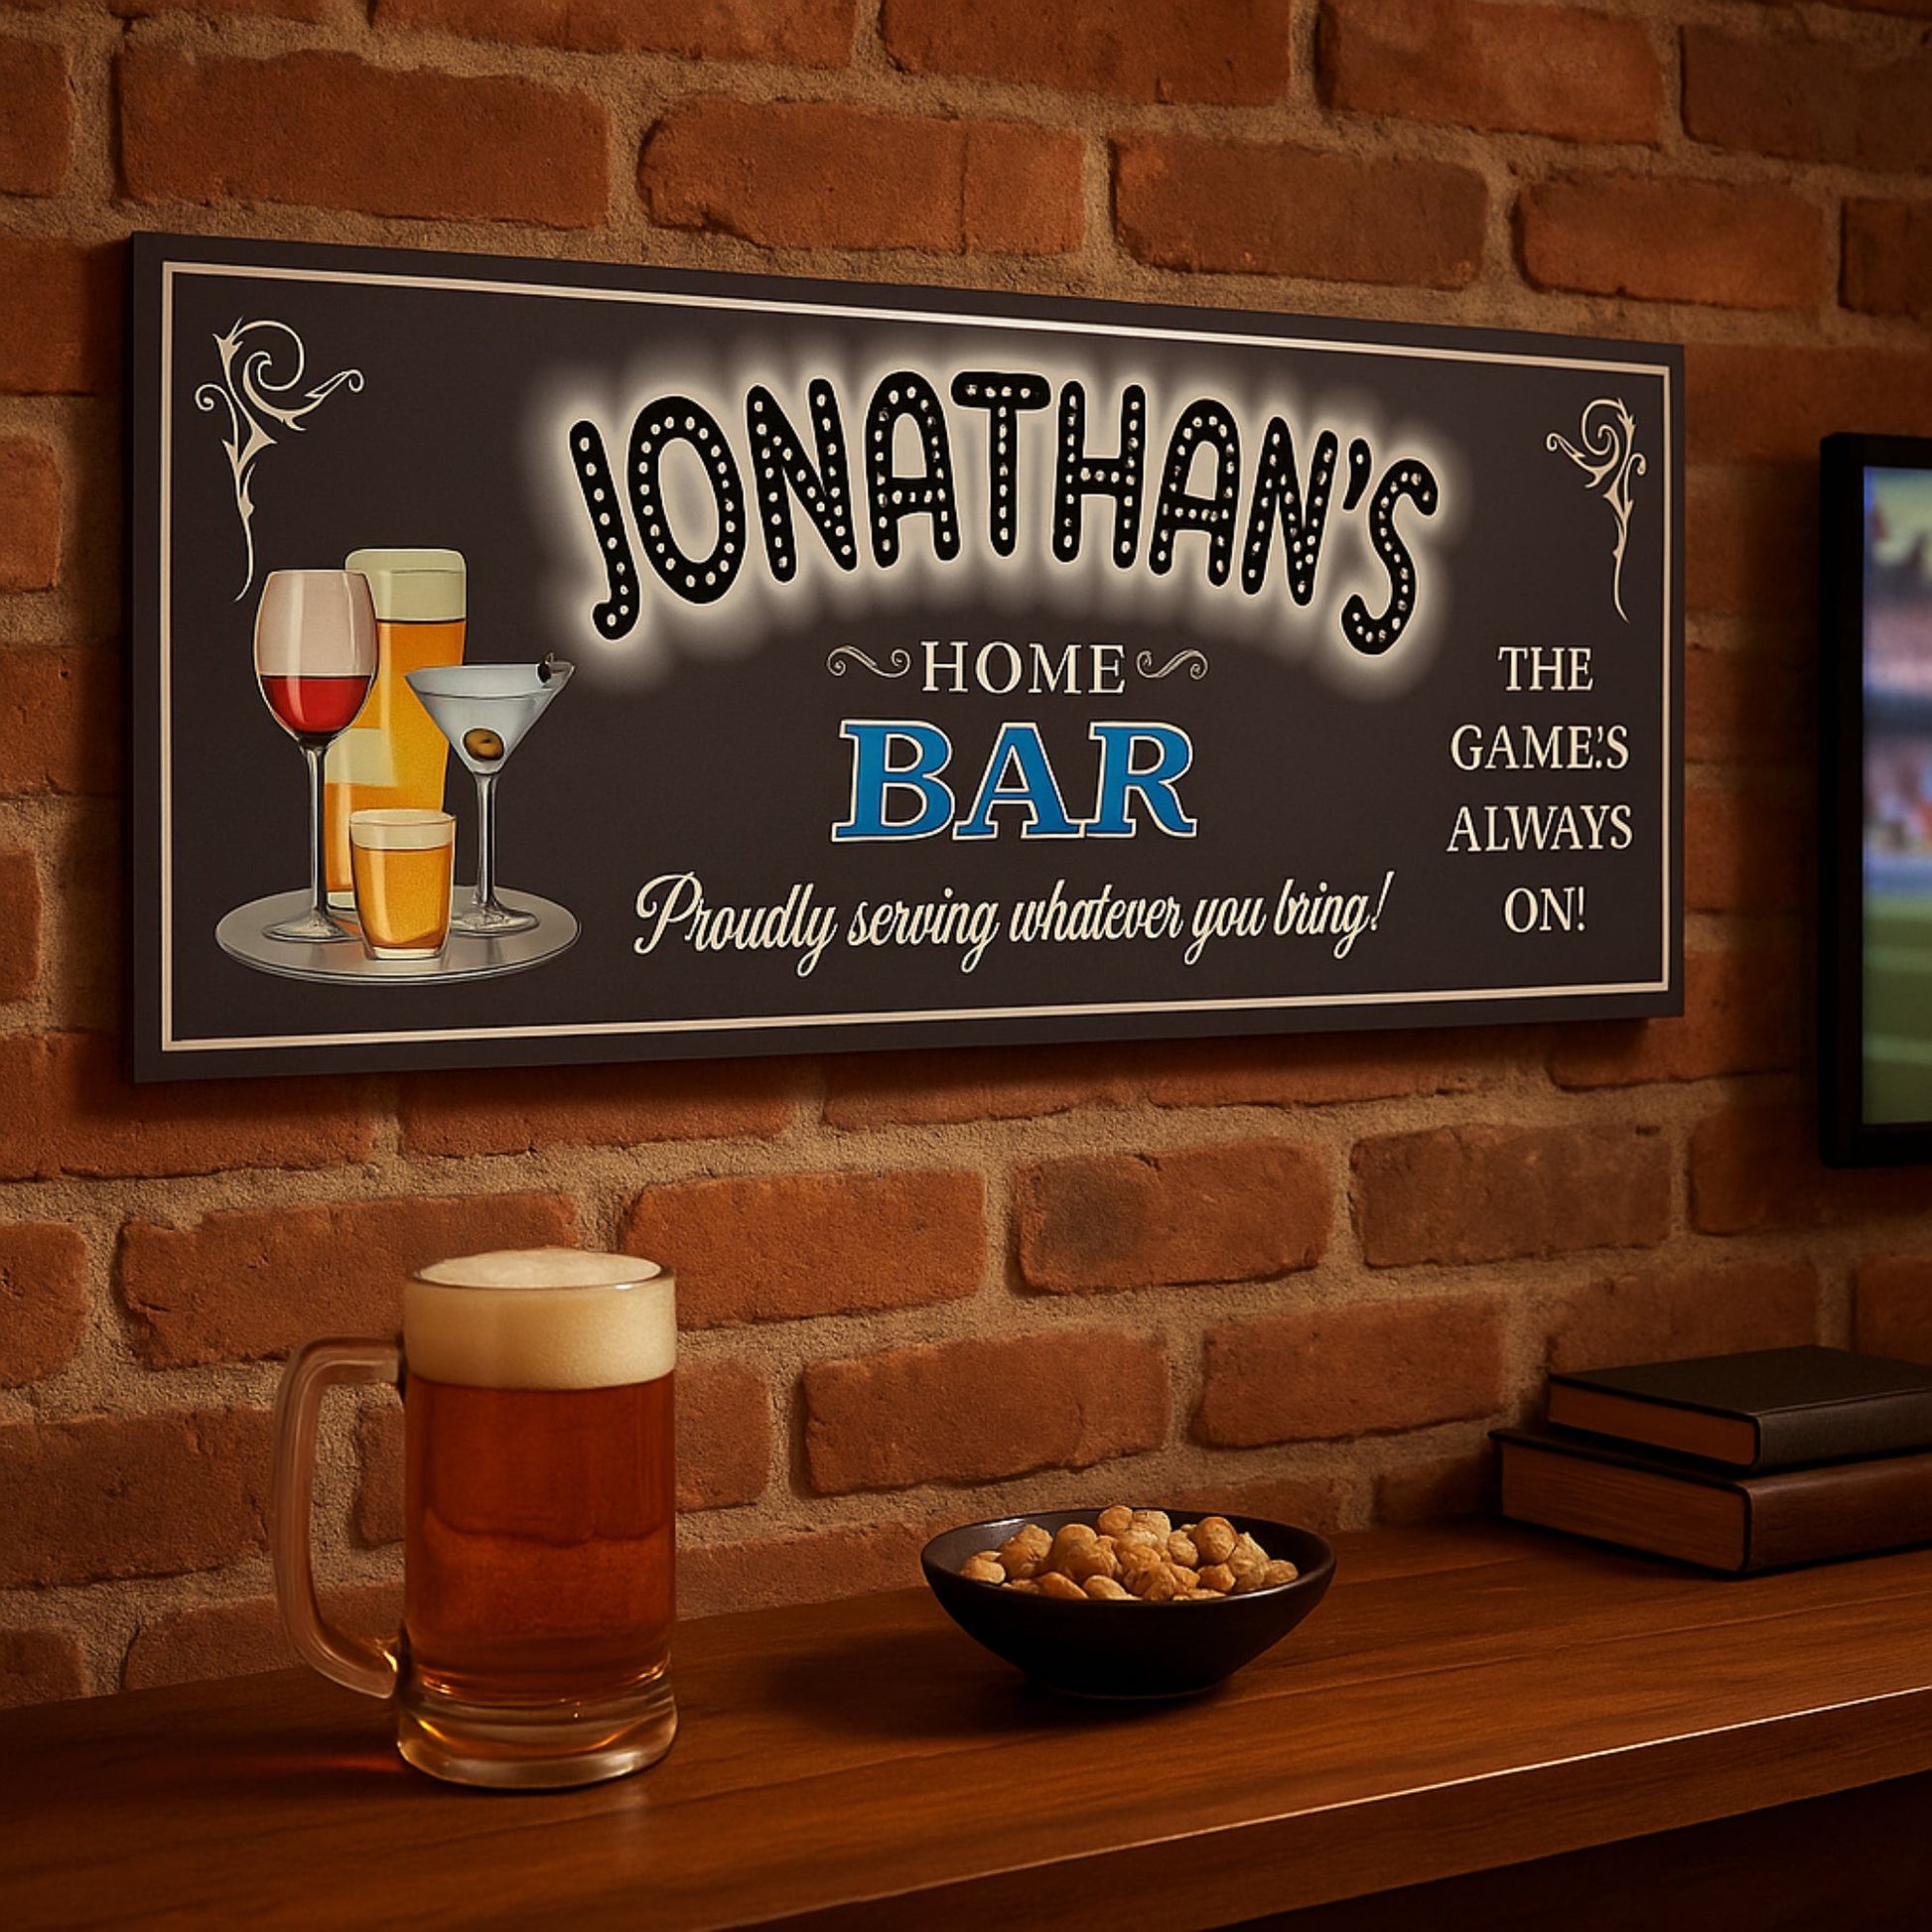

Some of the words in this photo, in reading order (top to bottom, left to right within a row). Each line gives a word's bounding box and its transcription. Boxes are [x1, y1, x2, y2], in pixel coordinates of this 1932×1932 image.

[568, 370, 1440, 656] JONATHAN'S
[921, 640, 1126, 695] HOME
[1497, 646, 1593, 691] THE
[831, 719, 1198, 843] BAR
[1447, 805, 1633, 852] ALWAYS
[634, 871, 838, 978] Proudly
[847, 887, 1000, 974] serving
[1009, 879, 1184, 942] whatever
[1184, 897, 1267, 965] you
[1273, 871, 1395, 960] bring!
[1504, 886, 1586, 933] ON!
